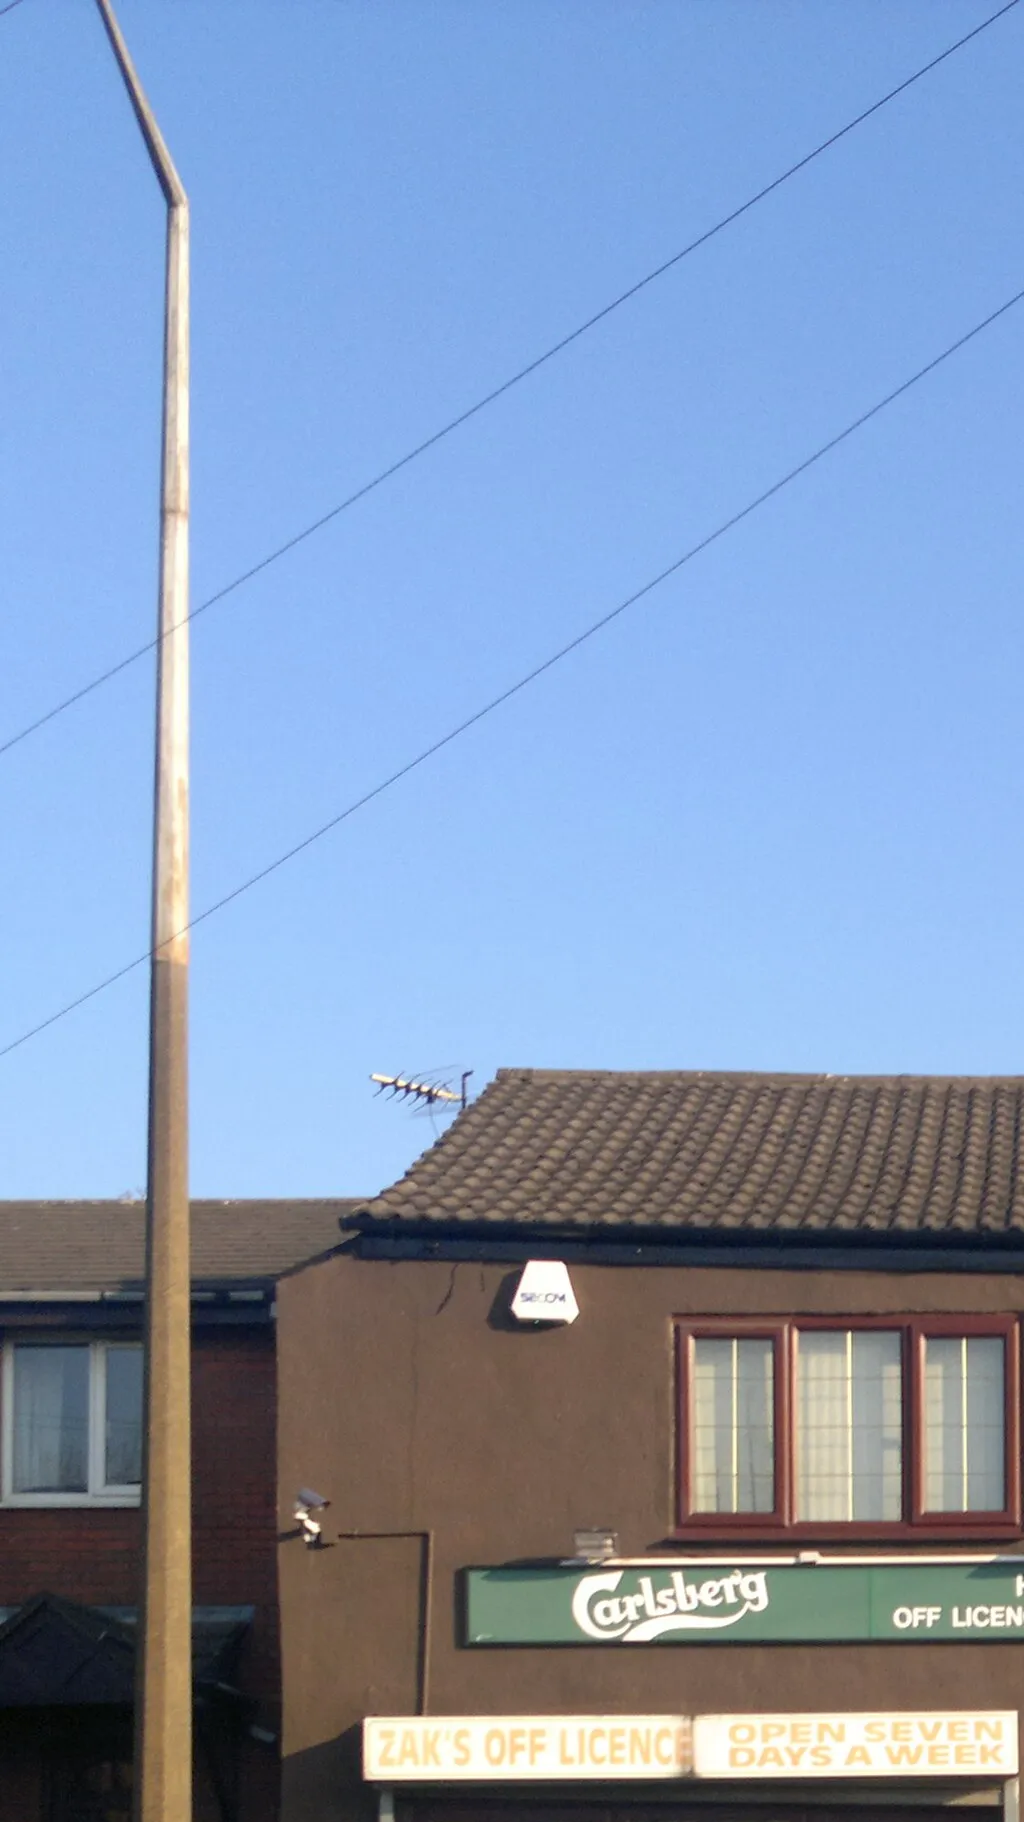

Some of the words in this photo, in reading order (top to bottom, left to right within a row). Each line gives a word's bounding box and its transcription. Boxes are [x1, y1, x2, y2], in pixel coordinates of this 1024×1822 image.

[572, 1569, 768, 1641] Carlsberg
[893, 1606, 942, 1629] OFF
[728, 1722, 846, 1745] OPEN
[864, 1720, 1003, 1743] SEVEN
[378, 1728, 471, 1767] ZAK'S
[484, 1728, 547, 1767] OFF
[559, 1727, 693, 1767] LICENCE
[728, 1745, 832, 1768] DAYS
[844, 1745, 873, 1767] A
[884, 1744, 1005, 1766] WEEK
